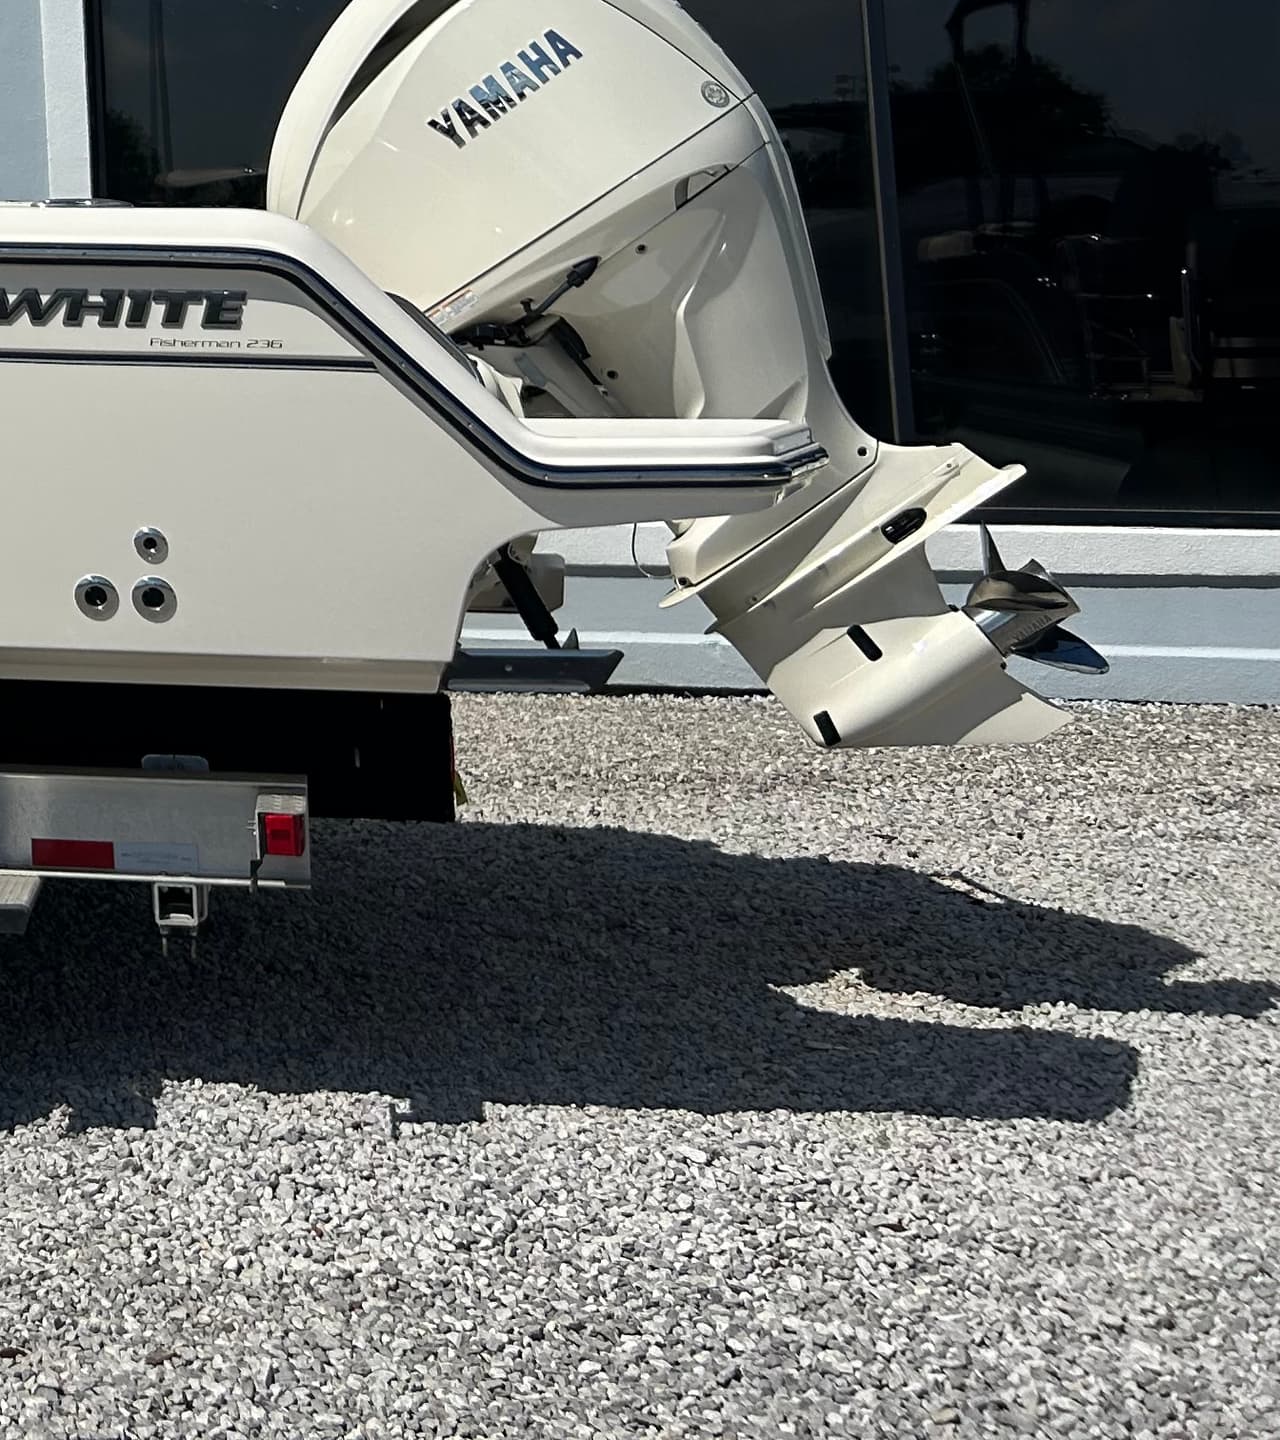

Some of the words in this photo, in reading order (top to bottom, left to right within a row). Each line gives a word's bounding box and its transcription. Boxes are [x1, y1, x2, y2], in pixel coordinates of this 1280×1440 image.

[427, 29, 583, 149] YAMAHA
[149, 337, 241, 348] Fisherman
[246, 339, 283, 349] 236
